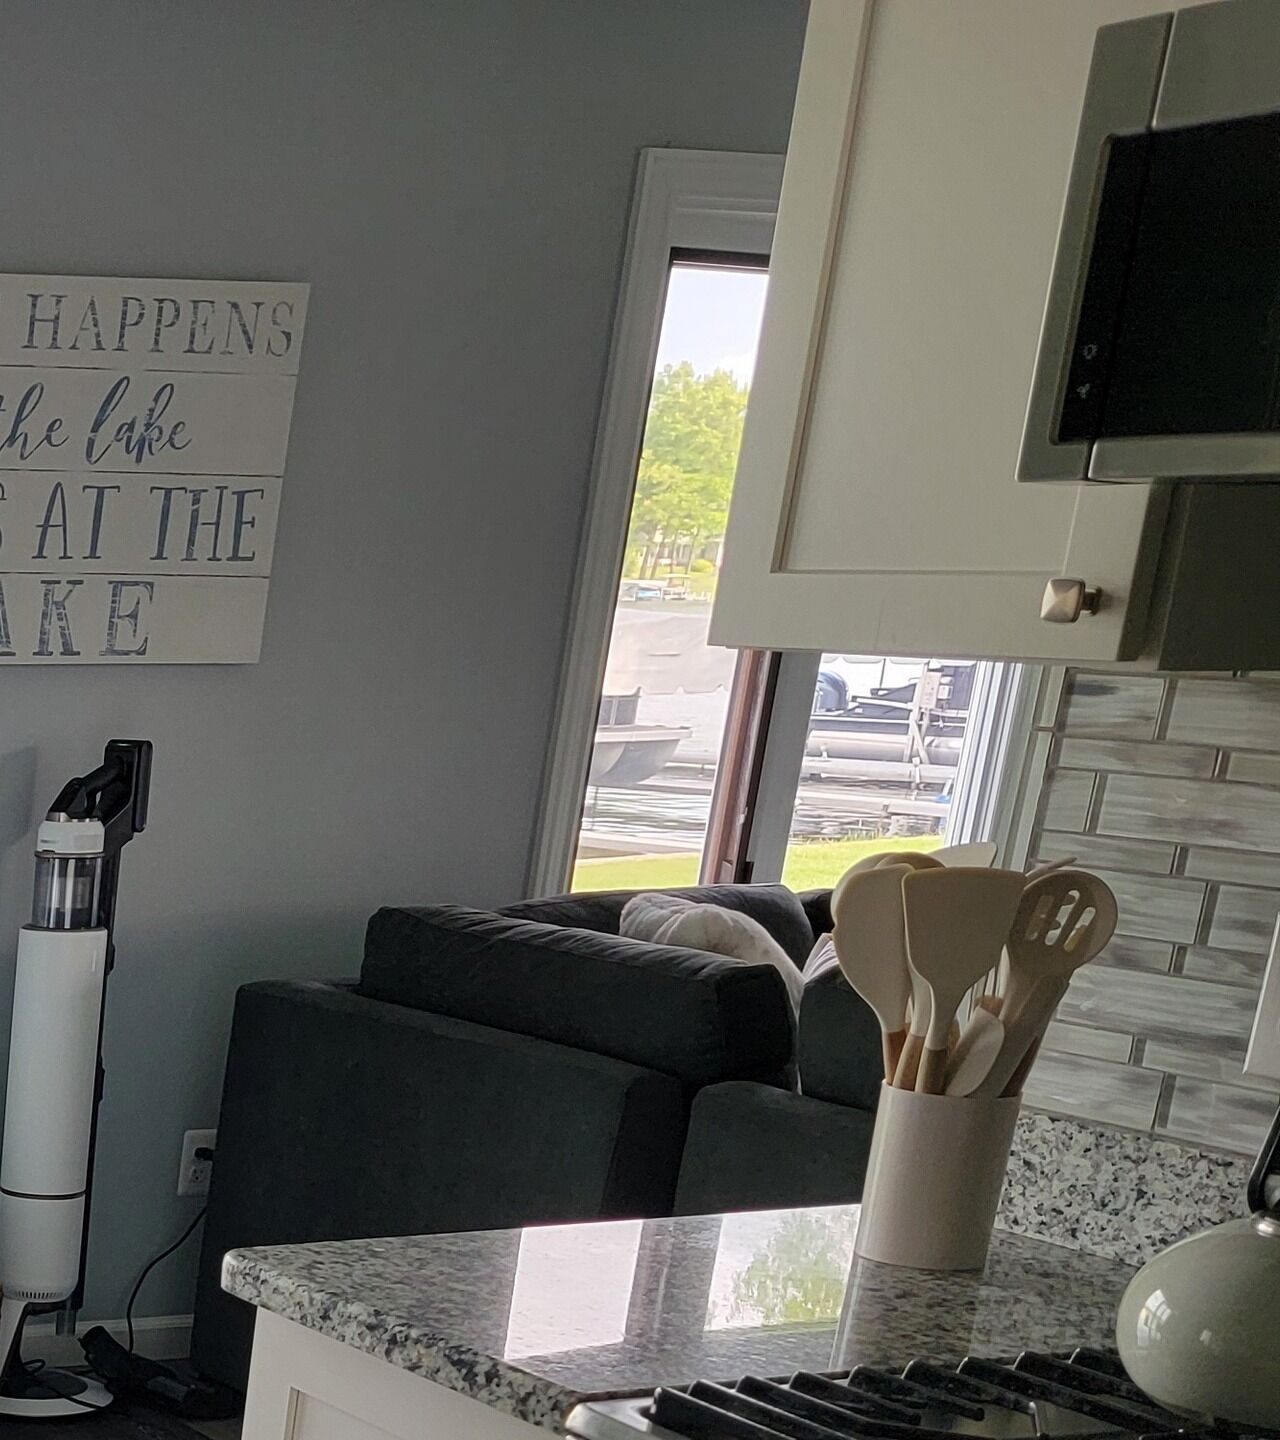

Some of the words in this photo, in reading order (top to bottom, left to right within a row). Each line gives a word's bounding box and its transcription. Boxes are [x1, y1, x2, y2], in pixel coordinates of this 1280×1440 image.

[21, 293, 295, 358] HAPPENS
[83, 376, 193, 465] lake
[32, 482, 120, 560] AT
[149, 486, 264, 562] THE
